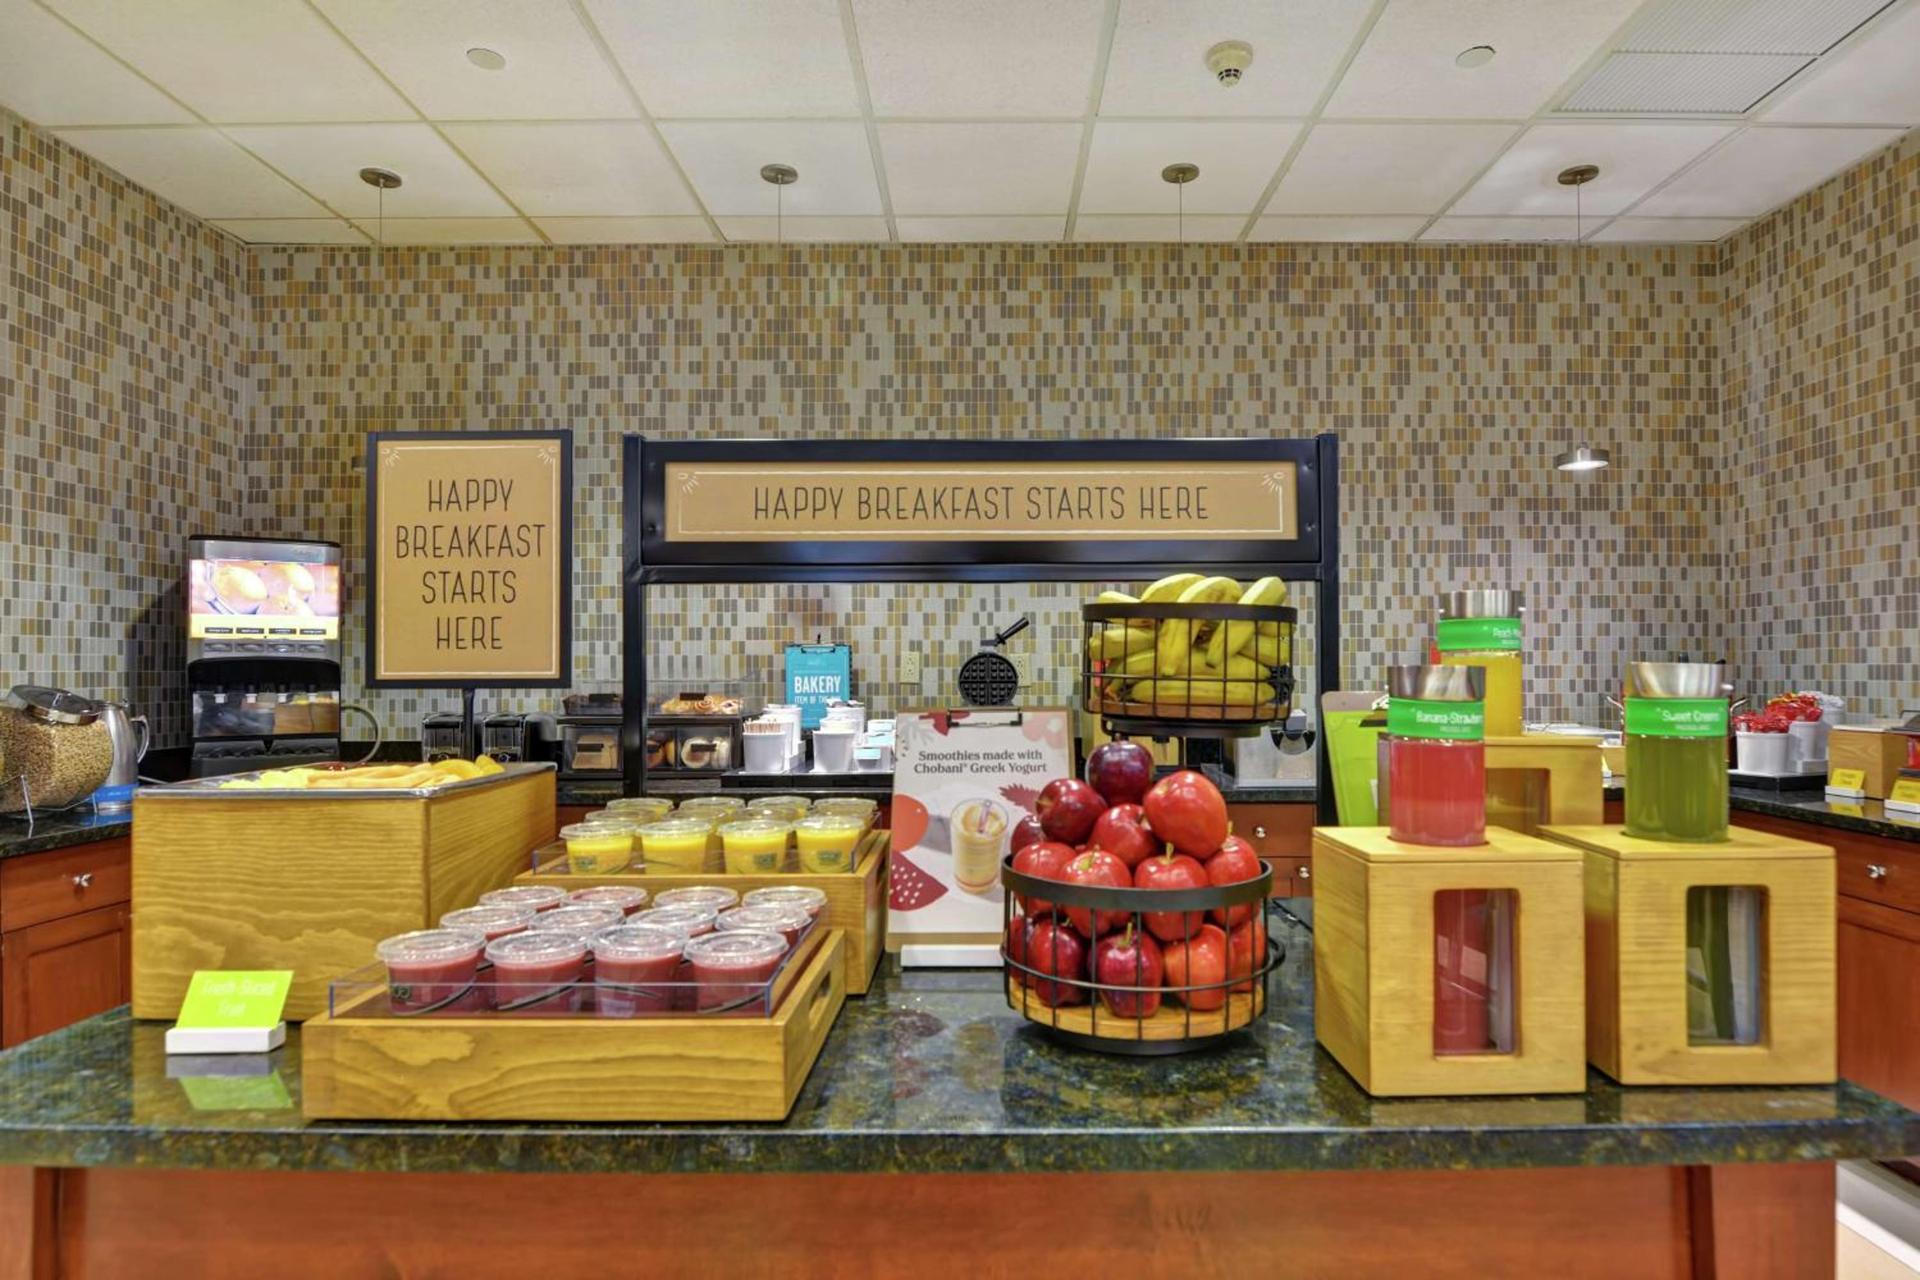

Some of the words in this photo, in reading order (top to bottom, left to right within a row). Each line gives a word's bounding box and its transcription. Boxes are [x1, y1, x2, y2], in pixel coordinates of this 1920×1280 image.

[428, 478, 513, 513] HAPPY
[754, 486, 844, 520] HAPPY
[858, 486, 1014, 520] BREAKFAST
[1026, 486, 1125, 520] STARTS
[1140, 486, 1209, 520] HERE
[396, 523, 546, 559] BREAKFAST
[421, 570, 517, 605] STARTS
[436, 615, 503, 650] HERE
[794, 675, 841, 694] BAKERY
[918, 750, 980, 761] Smoothies
[983, 750, 1014, 760] made
[1017, 749, 1043, 760] with
[970, 762, 1005, 773] Greek
[1008, 762, 1047, 775] Yogurt
